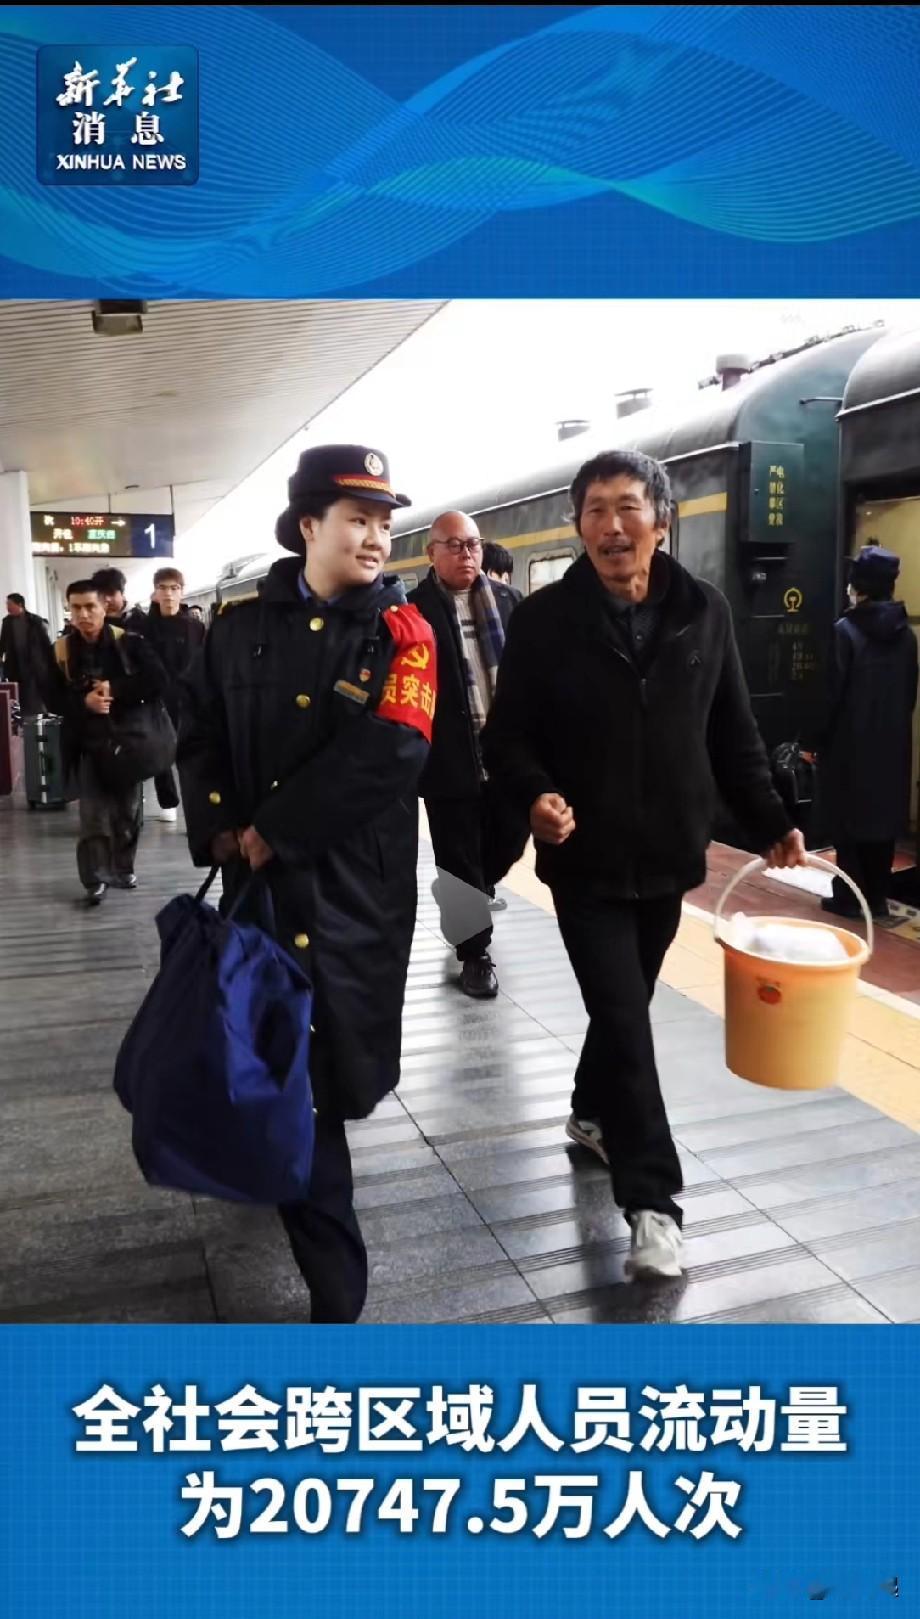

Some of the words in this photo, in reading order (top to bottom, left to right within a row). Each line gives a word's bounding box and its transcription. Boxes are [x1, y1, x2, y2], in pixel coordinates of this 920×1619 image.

[144, 523, 156, 549] 1
[382, 673, 437, 720] 员突击
